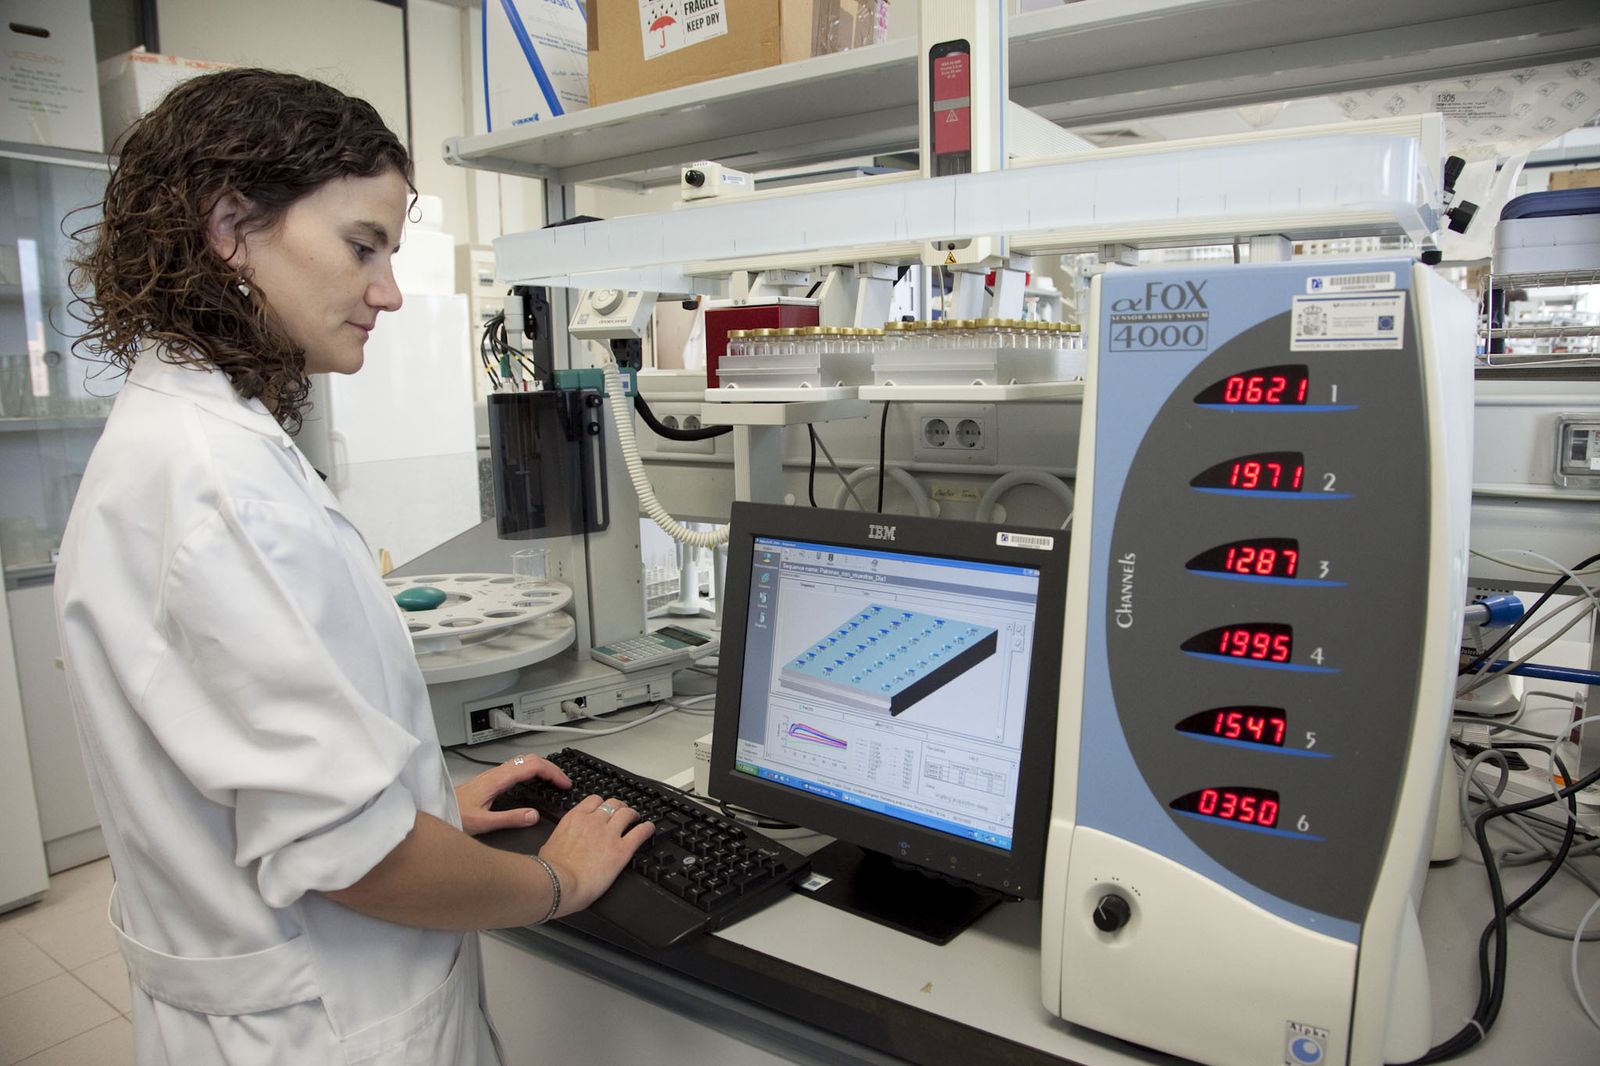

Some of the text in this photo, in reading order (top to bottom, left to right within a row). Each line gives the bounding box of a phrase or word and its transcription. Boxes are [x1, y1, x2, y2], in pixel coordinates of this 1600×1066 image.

[687, 12, 720, 32] KEEP DRY
[1437, 94, 1456, 103] 1305
[1176, 311, 1209, 319] SYSTEM
[1113, 324, 1204, 348] 4000
[1224, 377, 1308, 403] 0621
[1330, 384, 1338, 403] 1
[1230, 462, 1304, 489] 1971
[1322, 472, 1337, 492] 2
[868, 524, 897, 541] IBM
[1225, 547, 1298, 576] 1287
[1318, 560, 1331, 579] 3
[1219, 631, 1290, 662] 1995
[1309, 647, 1325, 665] 4
[1213, 713, 1285, 743] 1547
[1305, 731, 1317, 749] 5
[1199, 789, 1279, 826] 0350
[1296, 814, 1310, 832] 6
